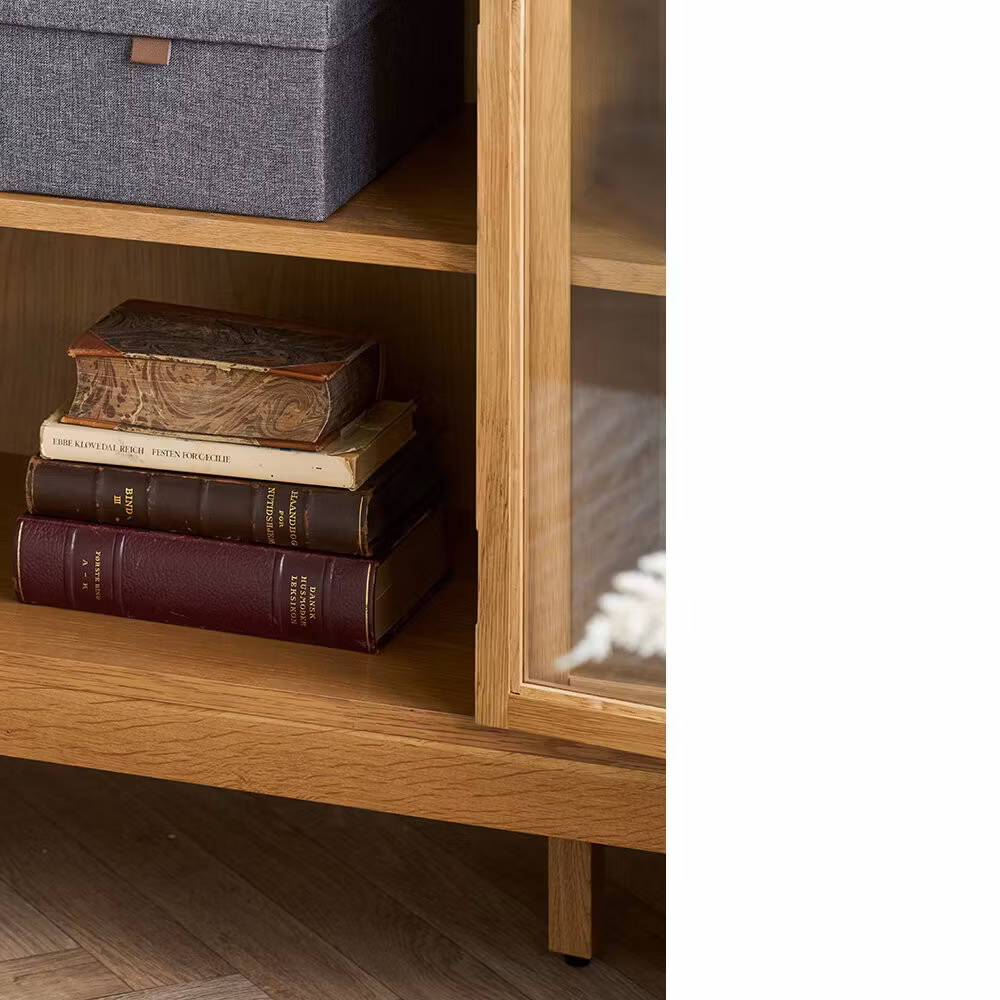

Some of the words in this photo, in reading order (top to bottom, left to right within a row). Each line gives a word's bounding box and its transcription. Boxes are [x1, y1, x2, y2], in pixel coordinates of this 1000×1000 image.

[52, 437, 73, 448] EBBE
[119, 444, 145, 455] REICH
[151, 447, 181, 459] FESTEN
[125, 487, 134, 515] BIND
[290, 575, 298, 625] LEKSIKON
[309, 586, 317, 620] DANSK
